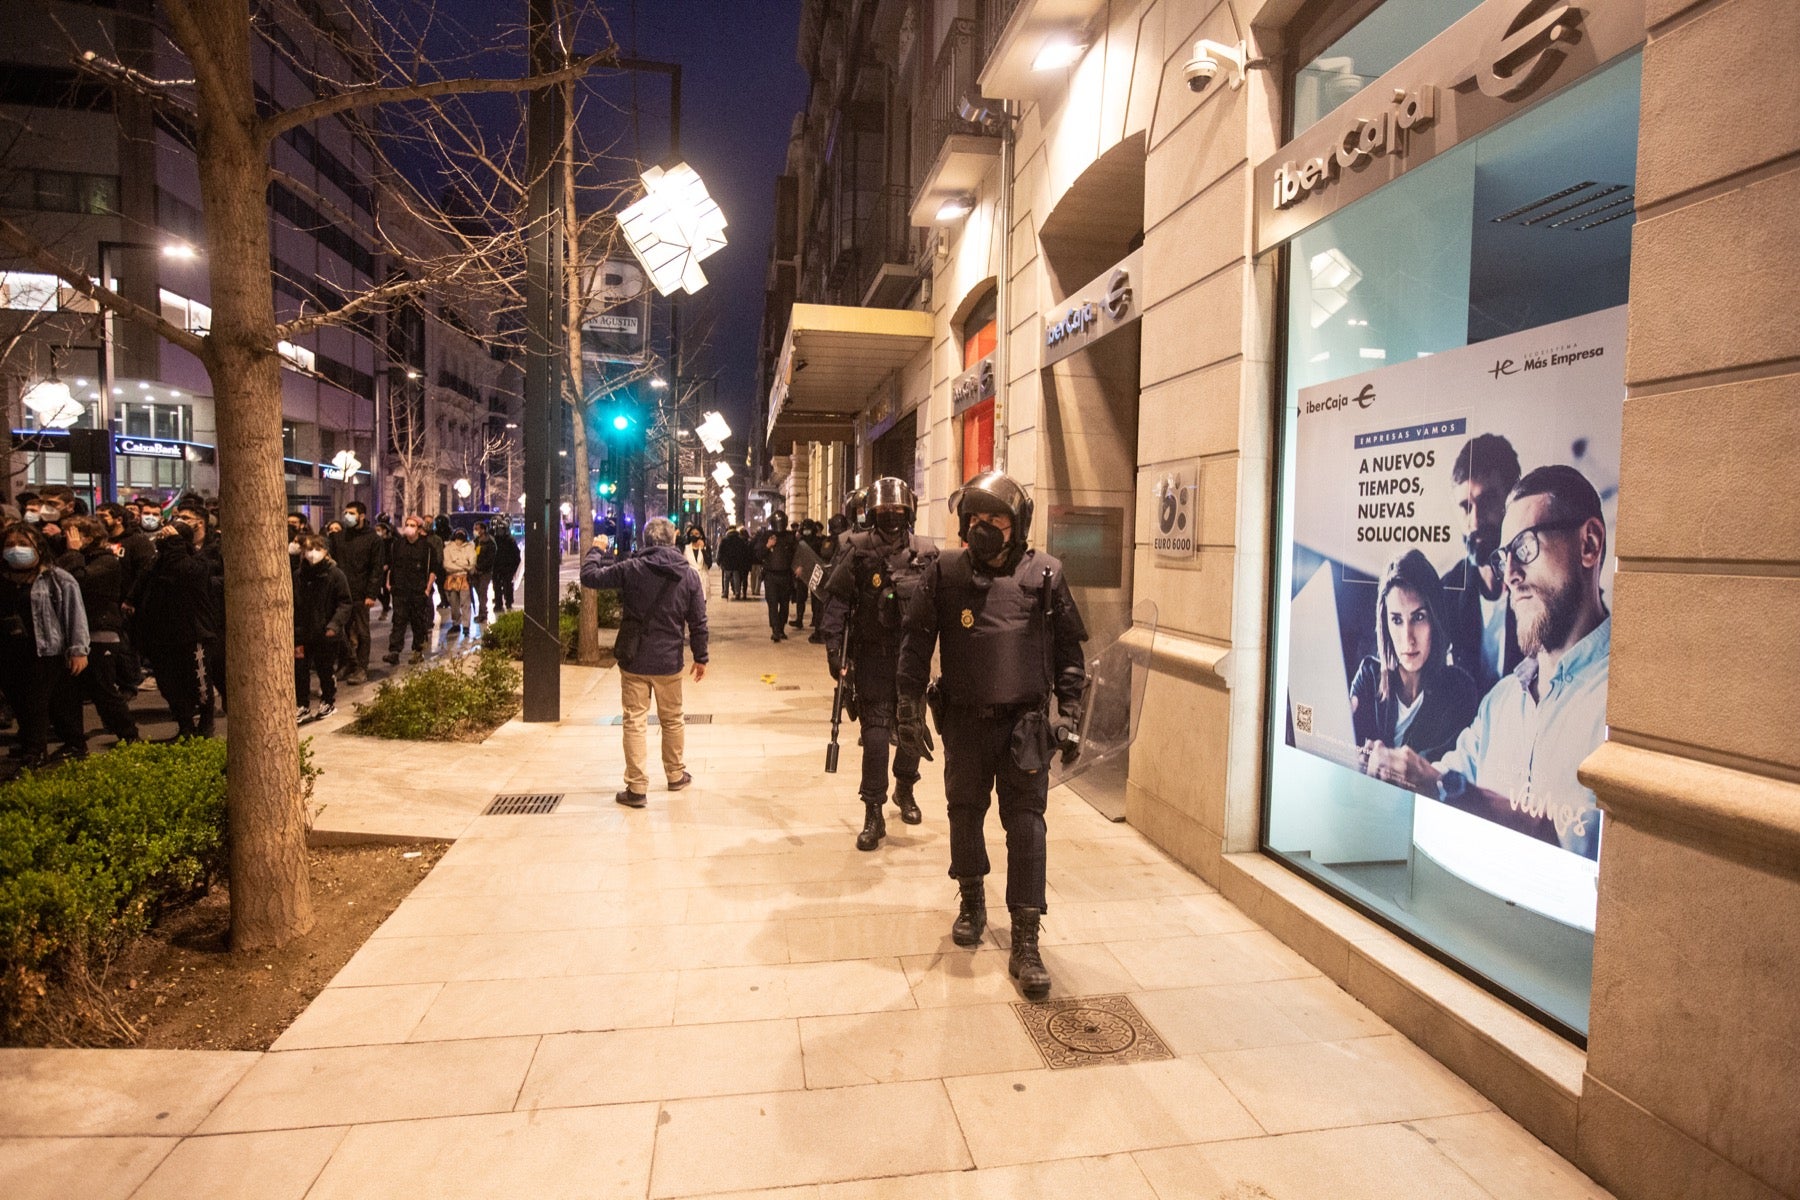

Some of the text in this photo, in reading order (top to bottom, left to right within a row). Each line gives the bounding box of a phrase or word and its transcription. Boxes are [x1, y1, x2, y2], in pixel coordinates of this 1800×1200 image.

[1273, 85, 1435, 210] iberCaja
[600, 316, 637, 327] AGUSTIN
[1524, 346, 1604, 371] Más Empresa
[1305, 393, 1349, 414] iberCaja
[1360, 423, 1456, 445] EMPRESAS VAMOS
[121, 440, 182, 455] CaixaBank
[1359, 450, 1436, 474] A NUEVOS
[1358, 477, 1425, 497] TIEMPOS,
[1357, 501, 1415, 519] NUEVAS
[1356, 525, 1451, 542] SOLUCIONES
[1154, 537, 1191, 551] EURO 6000
